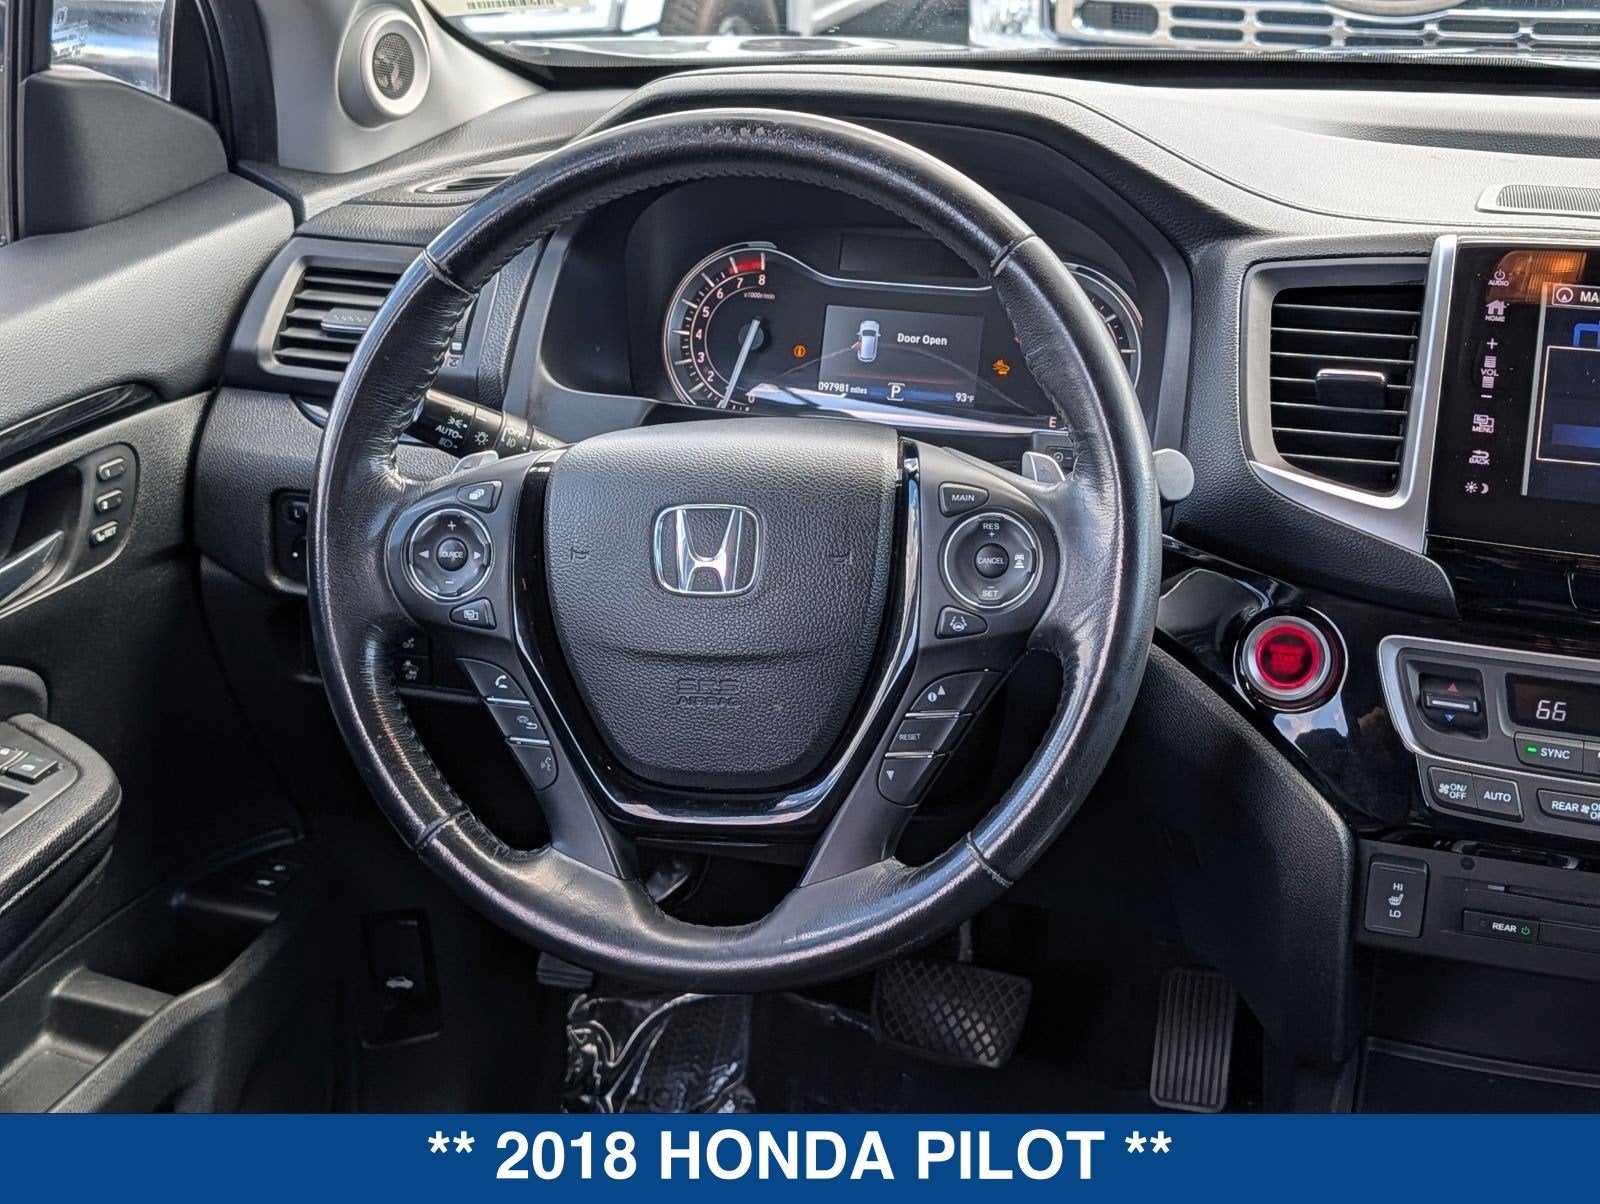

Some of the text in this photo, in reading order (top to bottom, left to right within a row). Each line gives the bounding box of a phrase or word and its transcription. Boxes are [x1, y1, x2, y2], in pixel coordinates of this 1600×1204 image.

[736, 277, 744, 289] 7
[758, 274, 766, 286] 8
[1488, 279, 1510, 287] AUDIO
[716, 288, 724, 299] 6
[1580, 290, 1599, 303] MA
[702, 306, 710, 318] 5
[1485, 315, 1506, 323] HOME
[695, 328, 703, 340] 4
[897, 332, 948, 347] Door Open
[697, 351, 705, 363] 3
[707, 370, 715, 382] 2
[1480, 368, 1499, 377] VOL
[818, 381, 868, 395] 097981 miles
[1048, 416, 1057, 429] E
[434, 424, 460, 439] AUTO
[1471, 425, 1495, 434] MENU
[1469, 456, 1490, 466] BACK
[951, 493, 975, 503] MAIN
[982, 522, 1000, 531] RES
[977, 556, 1006, 566] CANCEL
[981, 589, 999, 599] SET
[1535, 699, 1567, 722] 66
[899, 732, 921, 742] RESET
[1540, 747, 1571, 760] SYNC
[1448, 791, 1467, 800] OFF
[1483, 790, 1512, 803] AUTO
[1551, 800, 1580, 813] REAR
[1392, 882, 1403, 892] HI
[1388, 909, 1402, 919] LO
[1491, 922, 1518, 934] REAR
